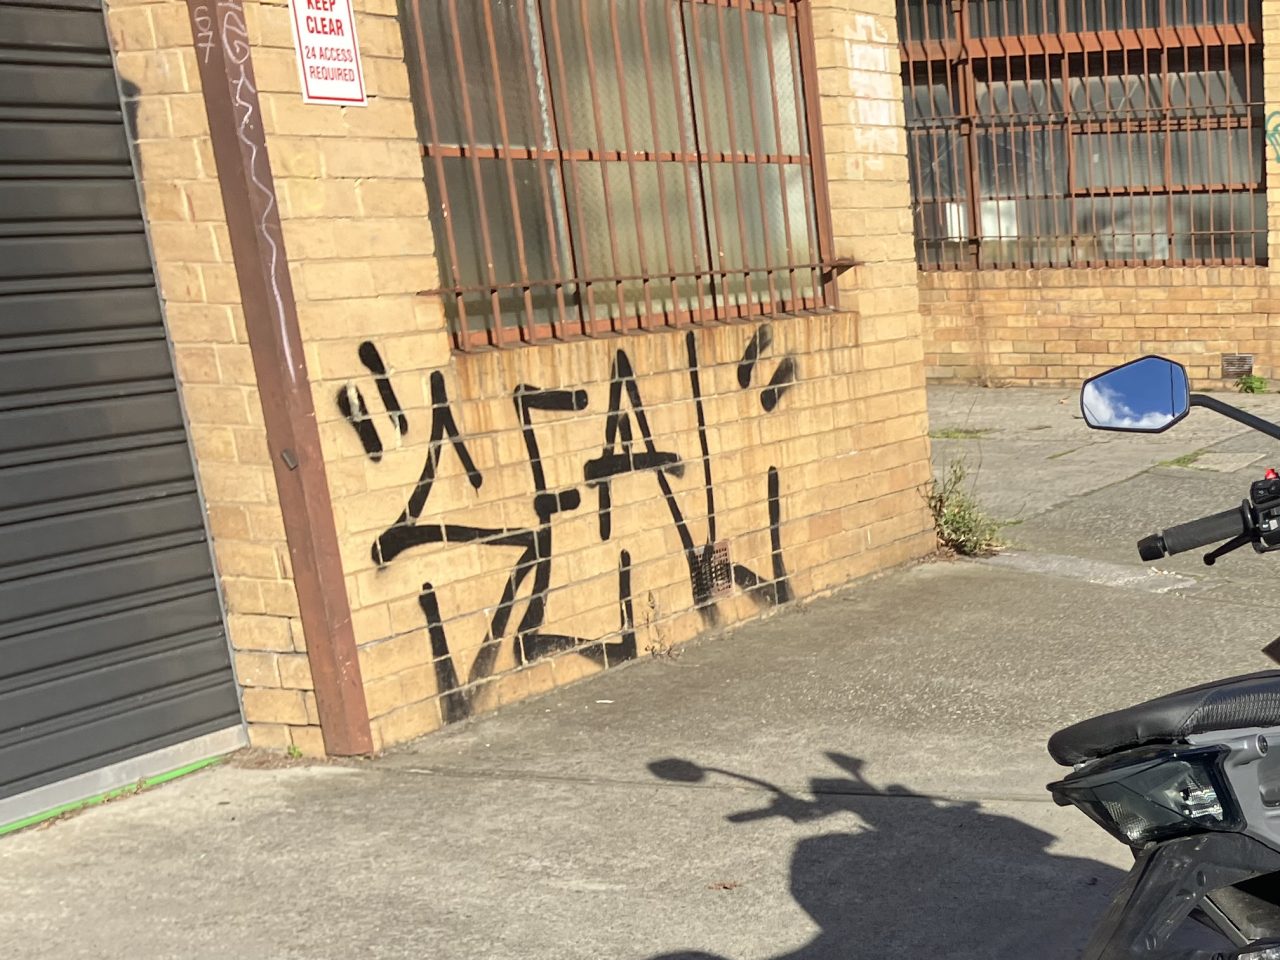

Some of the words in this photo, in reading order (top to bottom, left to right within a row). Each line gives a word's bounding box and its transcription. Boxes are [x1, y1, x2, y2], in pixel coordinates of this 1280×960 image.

[306, 16, 344, 36] CLEAR
[305, 45, 317, 60] 24
[319, 46, 353, 63] ACCESS
[309, 65, 355, 82] REQUIRED
